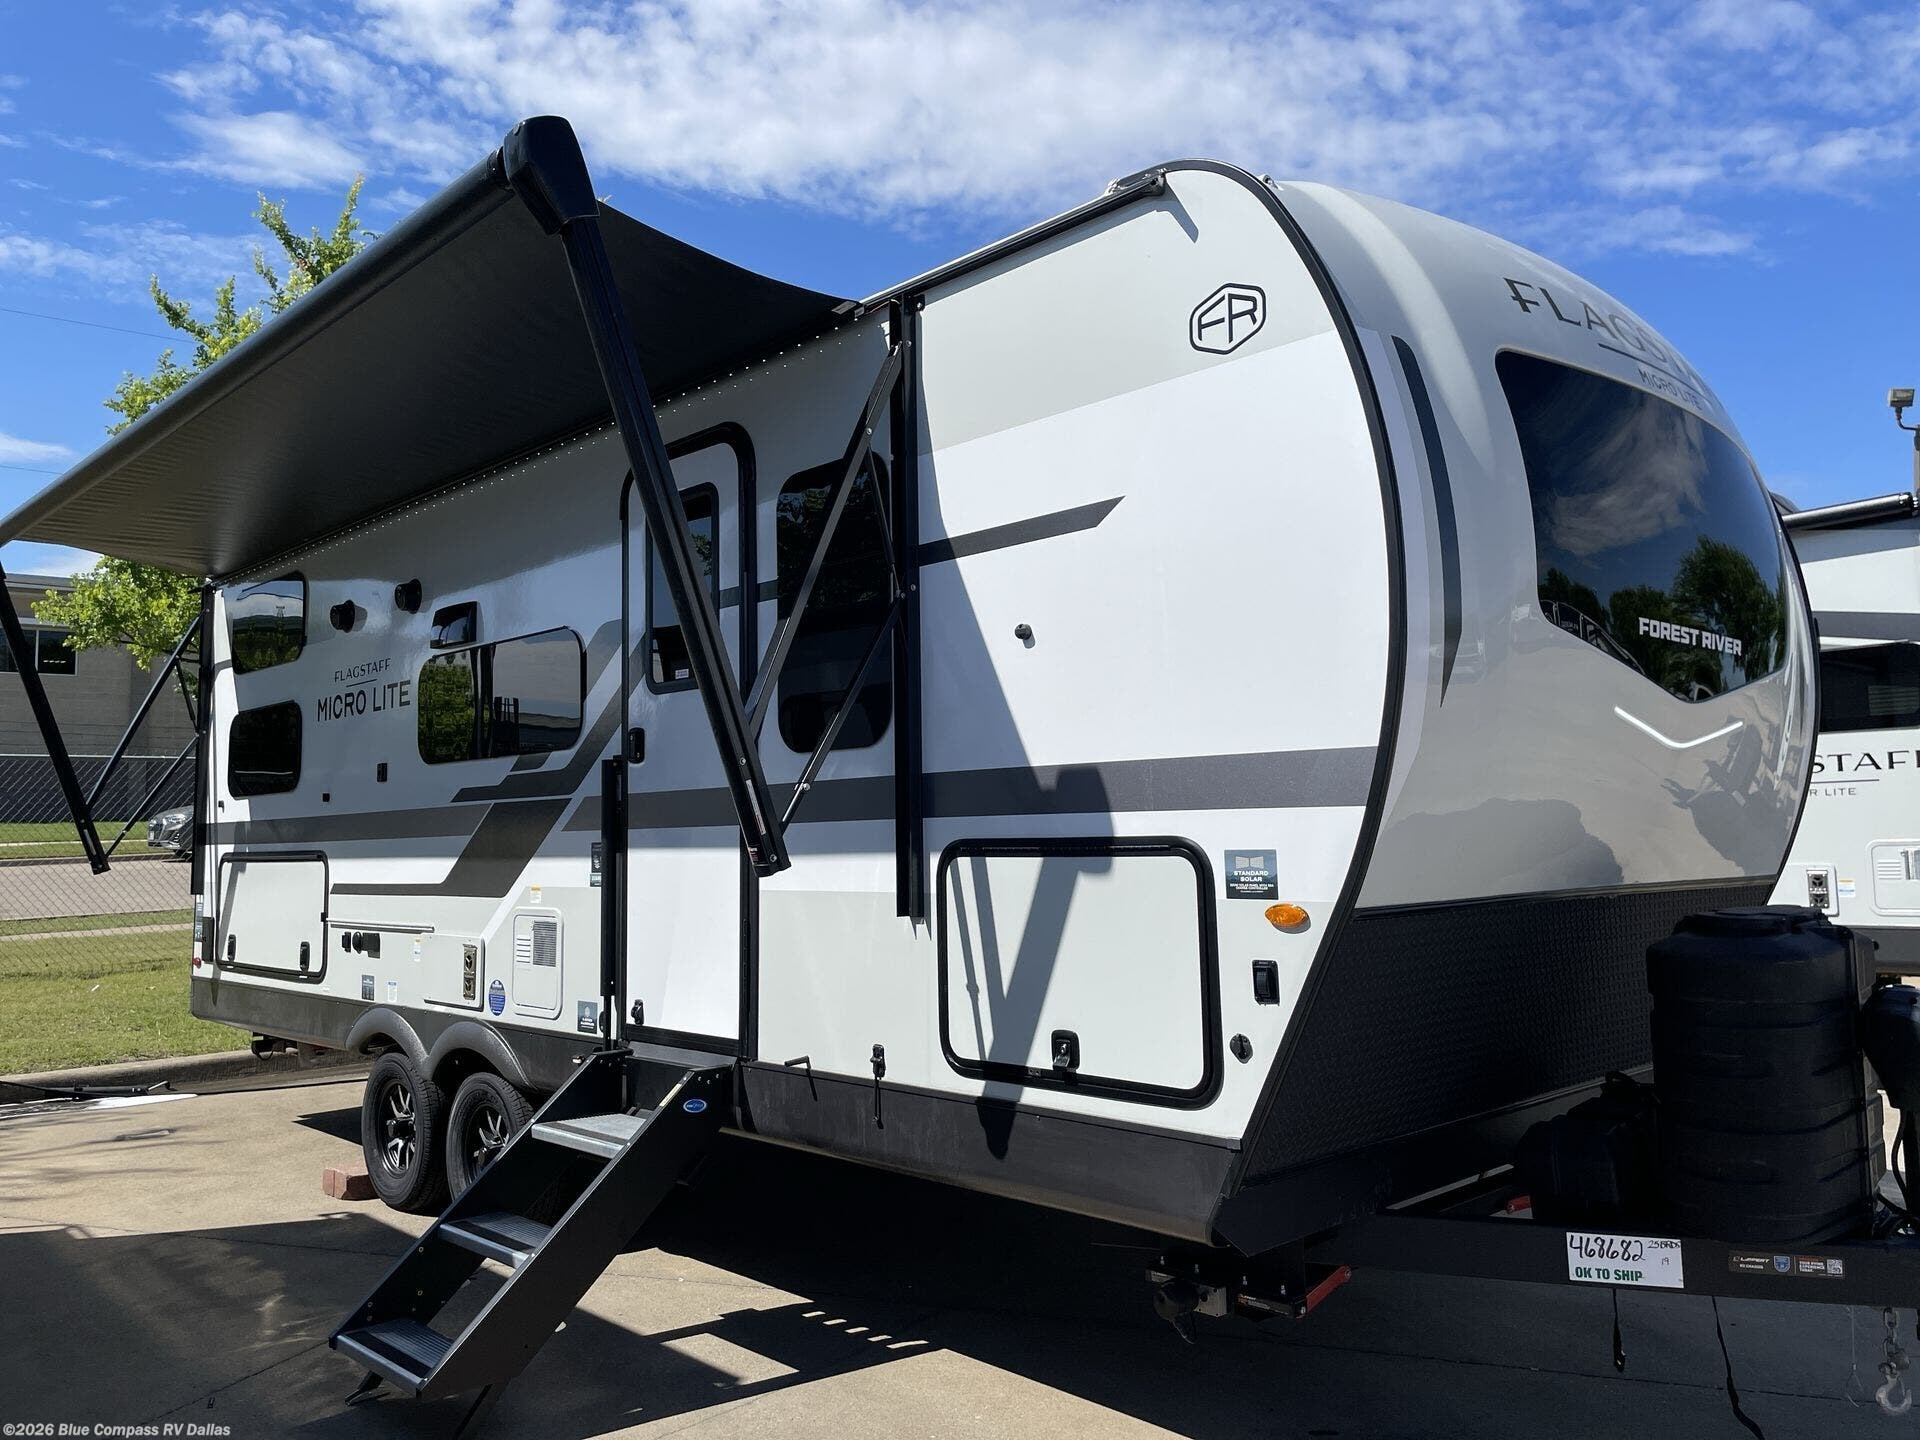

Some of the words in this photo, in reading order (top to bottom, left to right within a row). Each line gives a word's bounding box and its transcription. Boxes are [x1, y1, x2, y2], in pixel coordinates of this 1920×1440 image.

[1638, 368, 1677, 397] MICRO
[1638, 617, 1699, 646] FOREST
[1701, 631, 1742, 656] RIVER
[334, 658, 391, 683] FLAGSTAFF
[317, 689, 367, 722] MICRO
[373, 680, 411, 712] LITE
[1812, 750, 1920, 774] STAF
[1825, 787, 1856, 797] LITE
[1569, 1234, 1646, 1262] 468682
[1575, 1266, 1592, 1279] OK
[1595, 1268, 1610, 1280] TO
[1613, 1269, 1643, 1282] SHIP
